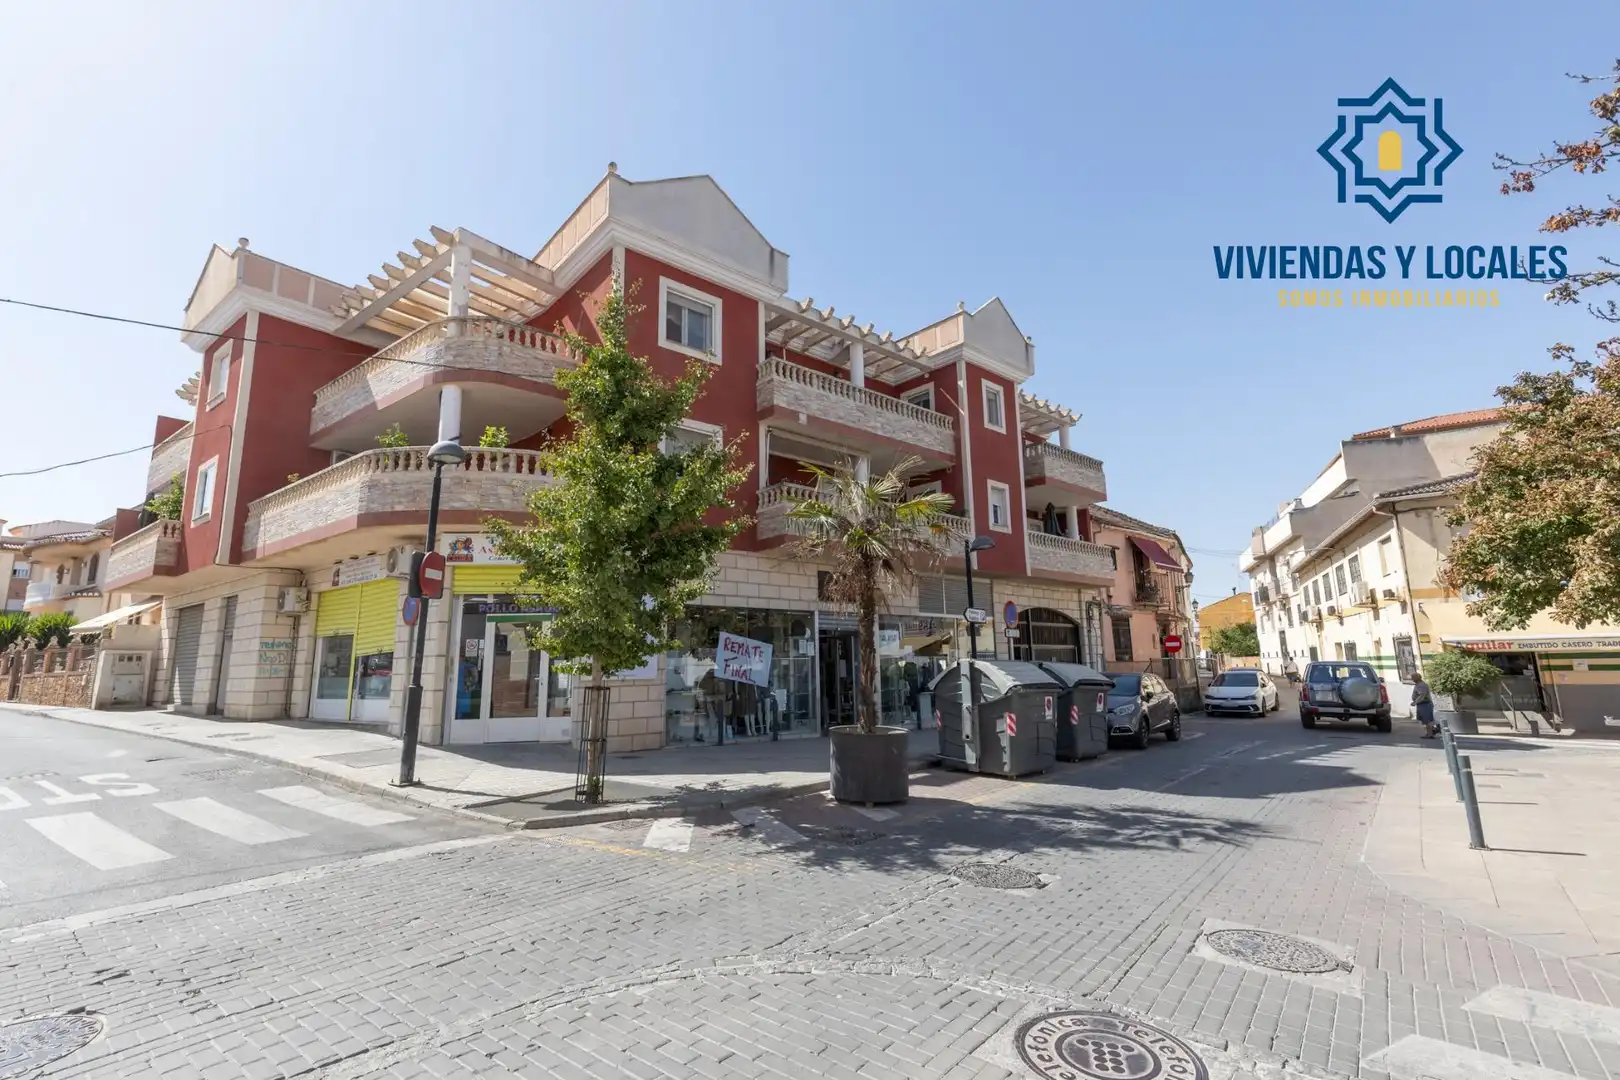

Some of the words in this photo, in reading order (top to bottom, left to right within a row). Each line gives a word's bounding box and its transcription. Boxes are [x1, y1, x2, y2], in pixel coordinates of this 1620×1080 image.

[479, 604, 518, 613] POLLO
[723, 636, 765, 663] REMATE
[723, 656, 757, 684] FINAL
